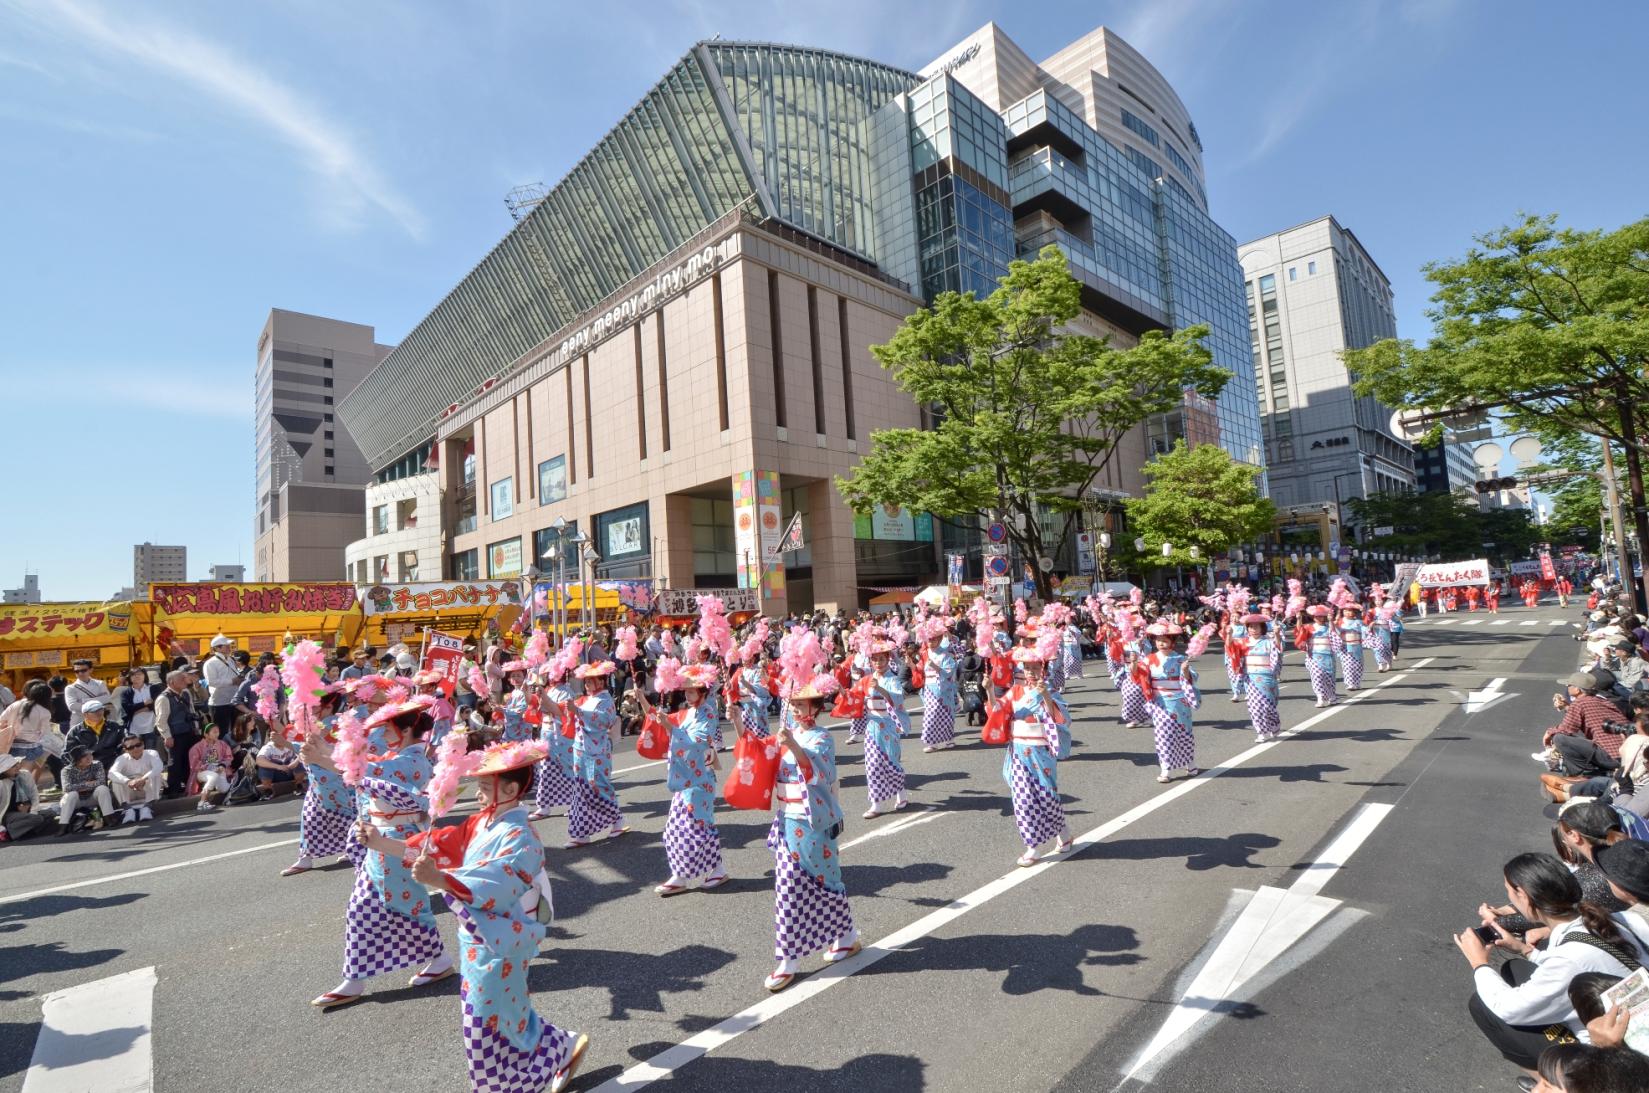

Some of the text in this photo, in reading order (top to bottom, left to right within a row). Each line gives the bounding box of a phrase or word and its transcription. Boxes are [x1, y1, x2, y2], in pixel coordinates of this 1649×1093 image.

[561, 245, 714, 355] eeny meeny miny mo
[171, 586, 345, 615] 広島風お好み焼き
[392, 584, 502, 610] チョコバナナ
